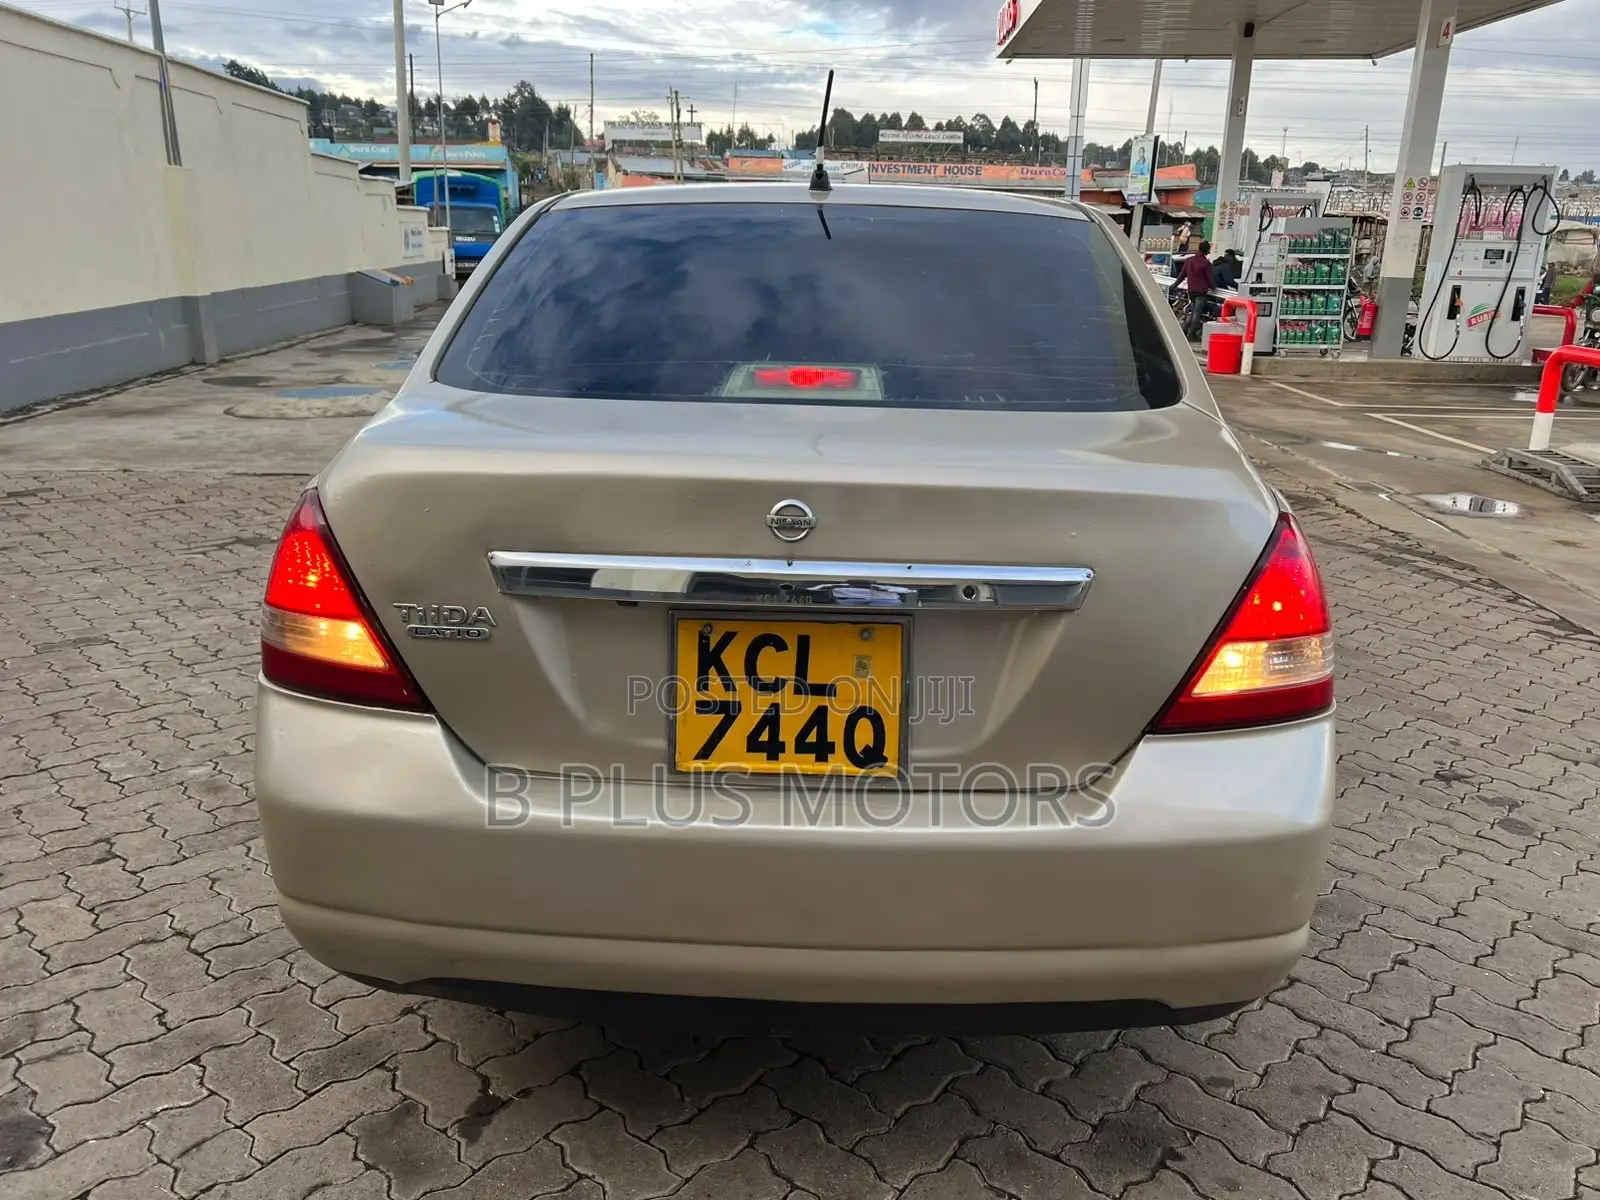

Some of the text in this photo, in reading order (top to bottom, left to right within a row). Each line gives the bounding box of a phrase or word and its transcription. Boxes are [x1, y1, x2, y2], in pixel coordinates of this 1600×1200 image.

[1442, 21, 1451, 39] 4
[943, 165, 982, 176] HOUSE
[771, 518, 811, 527] NISSAN
[697, 630, 837, 697] KCL
[693, 700, 889, 769] 744Q
